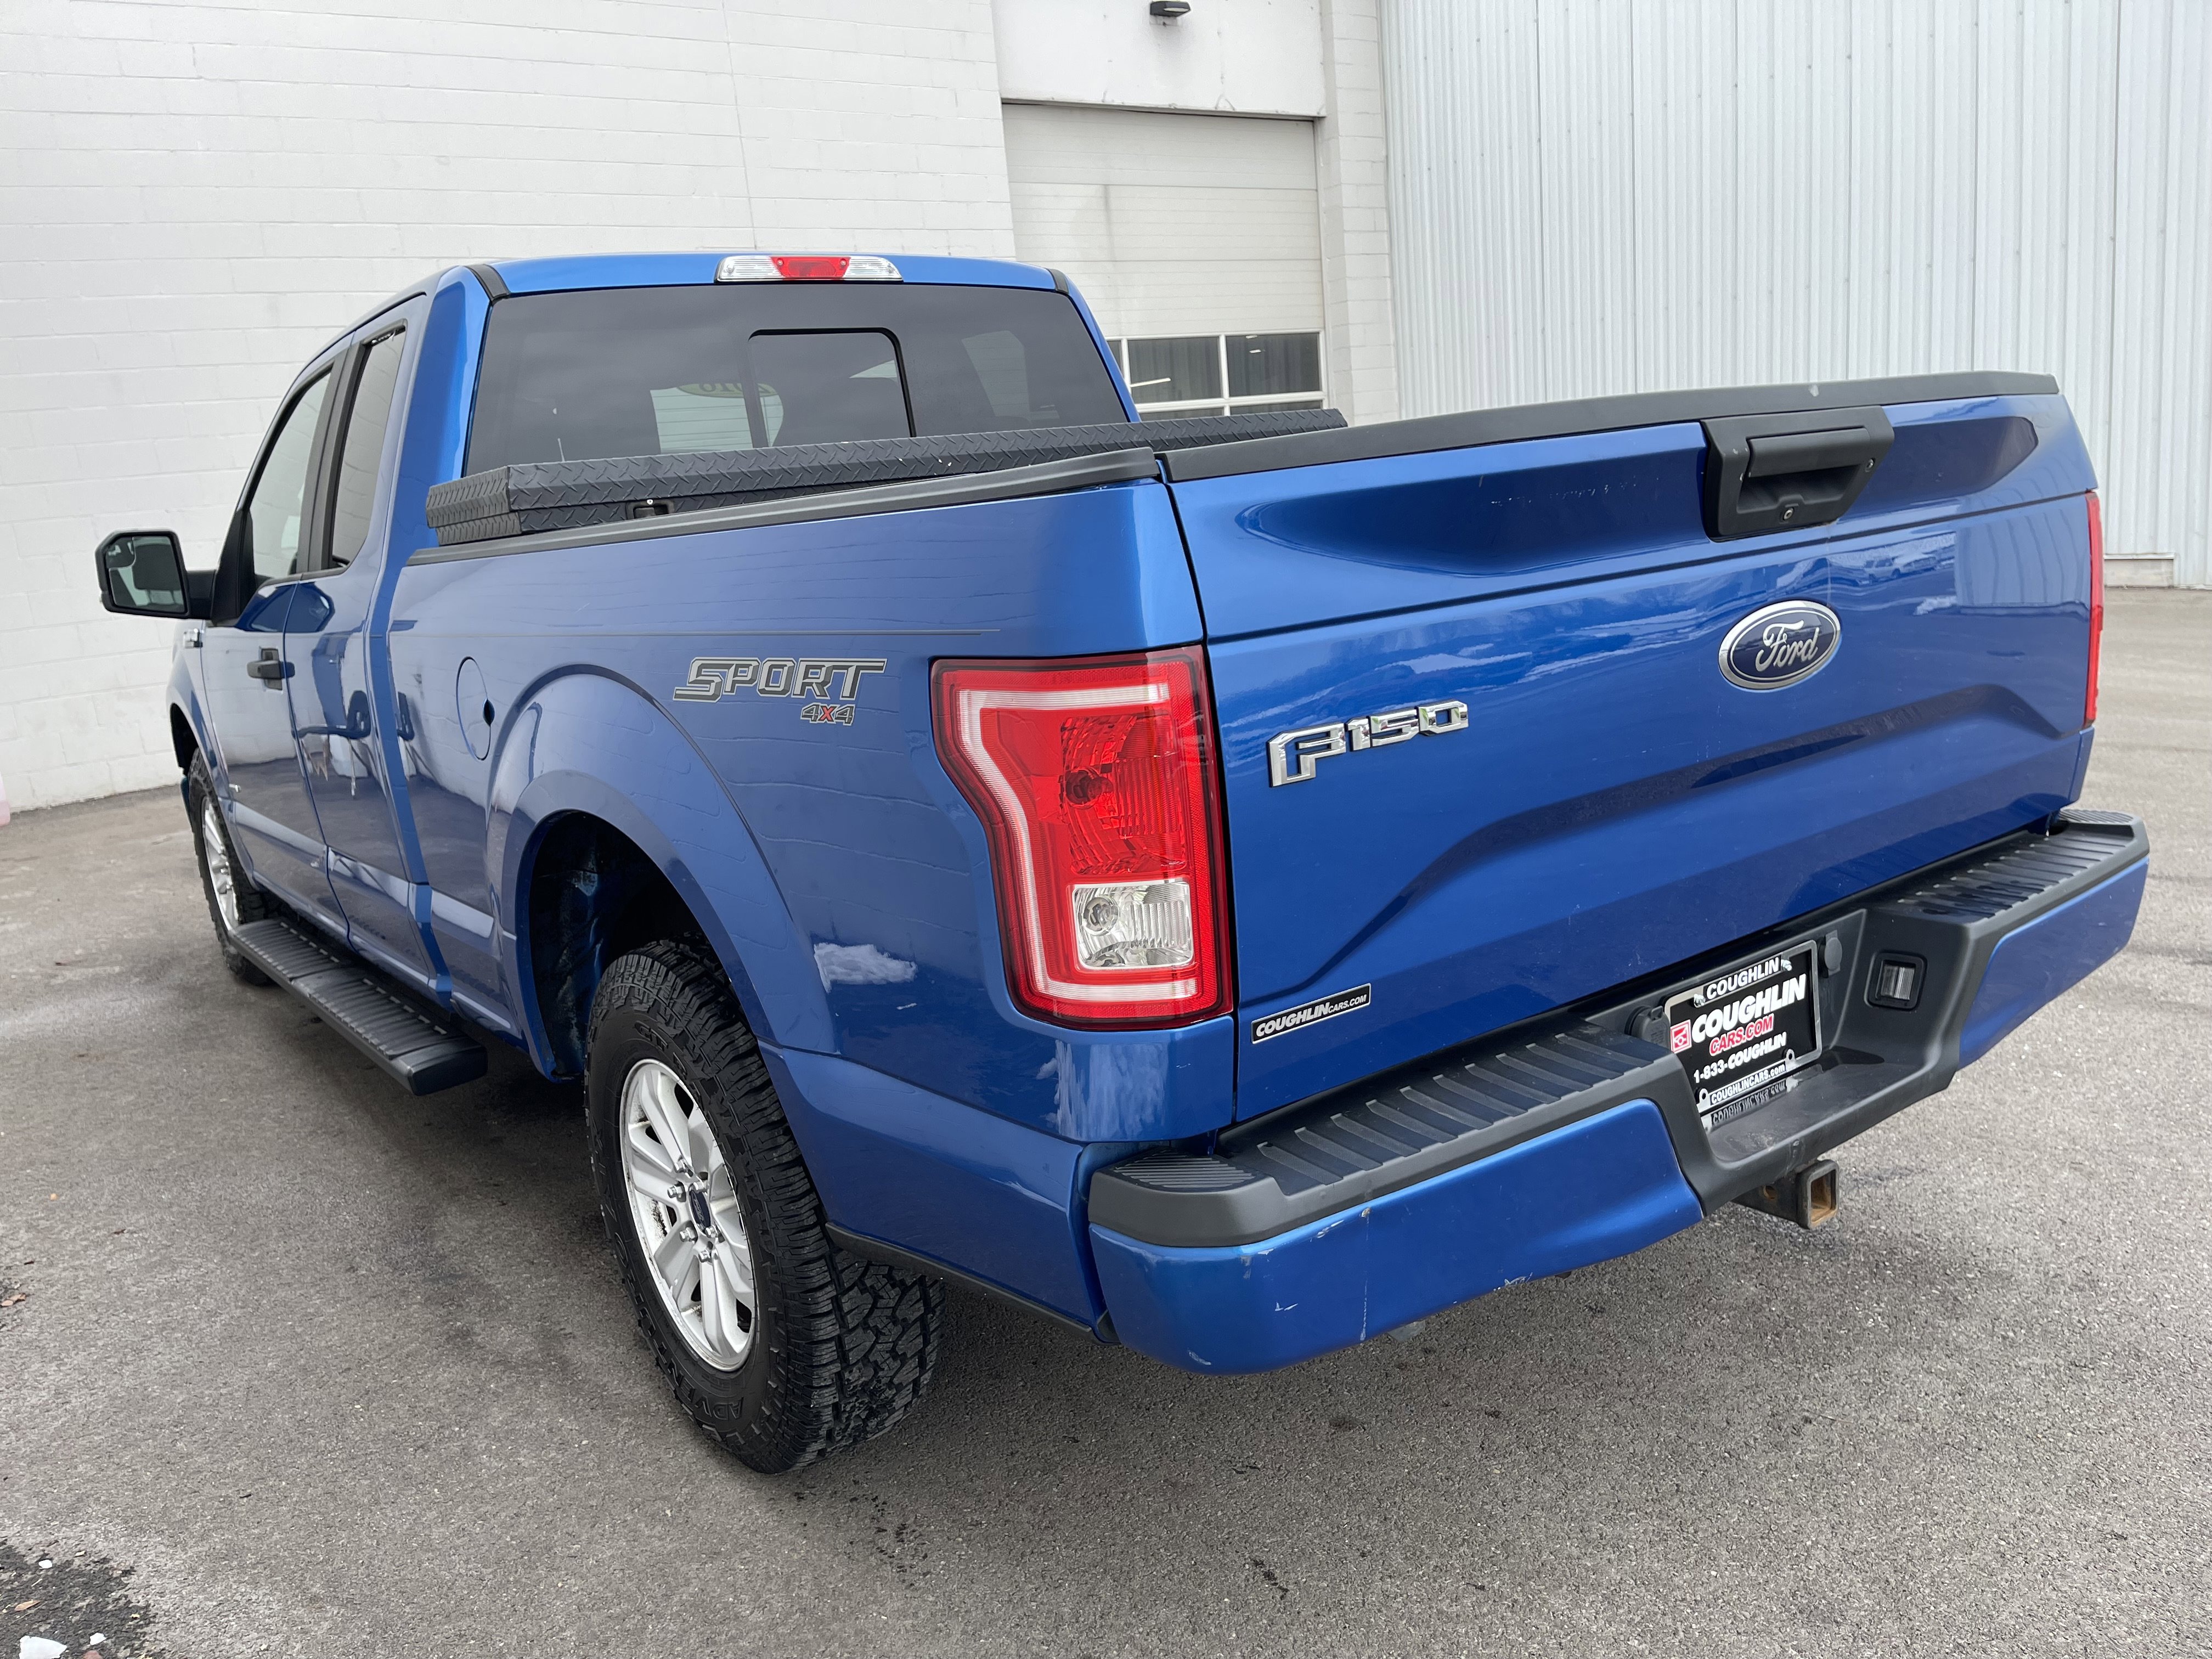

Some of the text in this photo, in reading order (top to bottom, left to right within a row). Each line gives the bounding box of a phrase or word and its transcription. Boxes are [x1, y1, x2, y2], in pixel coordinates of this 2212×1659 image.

[1755, 619, 1819, 672] Ford
[673, 657, 888, 703] SPORT
[1706, 957, 1779, 1000] COUGHLIN
[1691, 974, 1806, 1043] COUGHLIN
[1693, 1032, 1787, 1083] 1-833-COUGHLIN
[1709, 1013, 1774, 1057] CARS.COM
[1711, 1064, 1785, 1105] COUGHLINCARS.com
